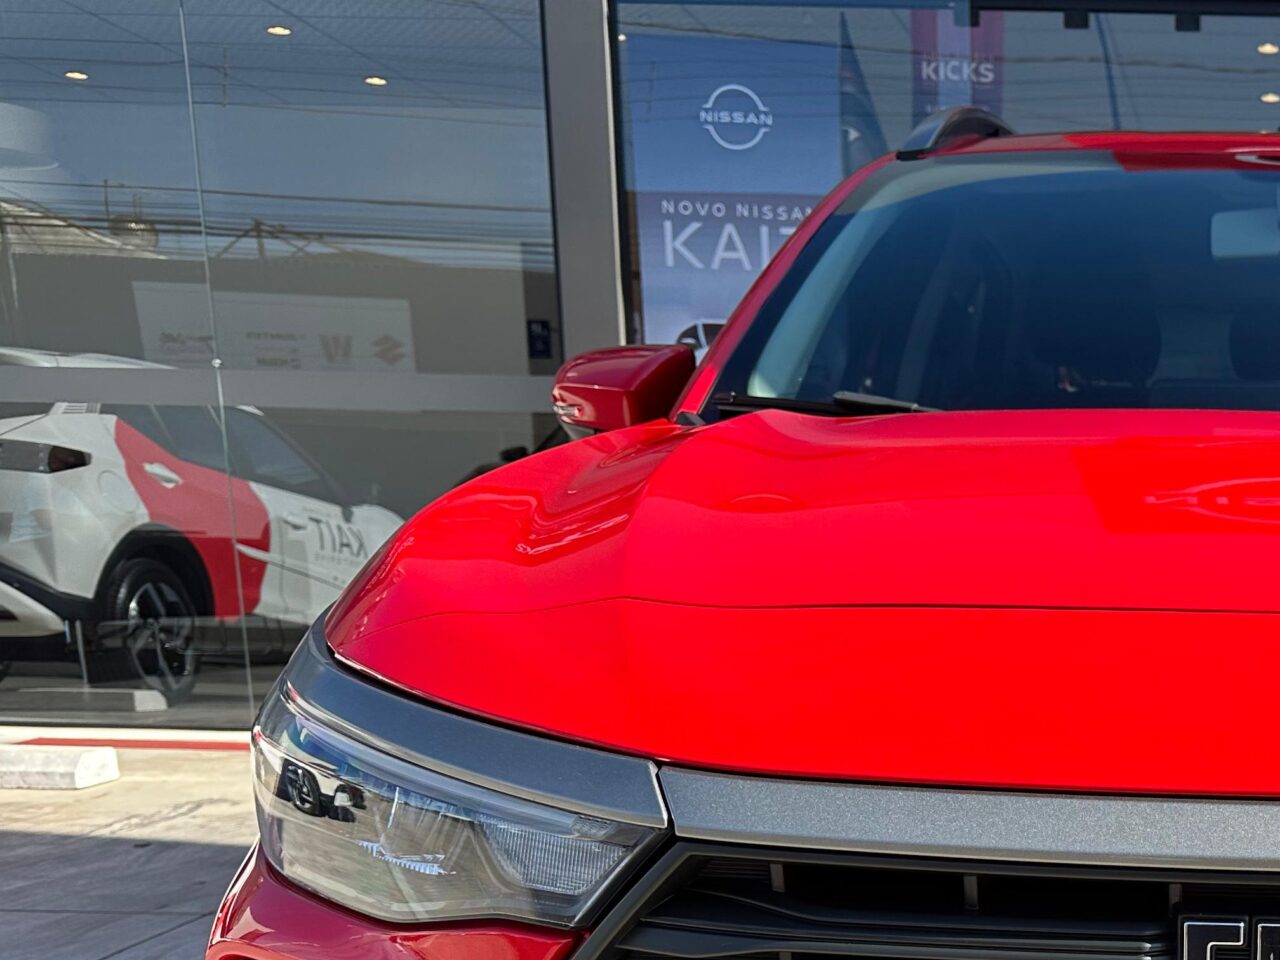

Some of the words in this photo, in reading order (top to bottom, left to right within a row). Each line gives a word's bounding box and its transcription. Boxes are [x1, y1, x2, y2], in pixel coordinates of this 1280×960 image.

[920, 60, 996, 84] KICKS
[700, 110, 773, 126] NISSAN
[661, 200, 727, 218] NOVO
